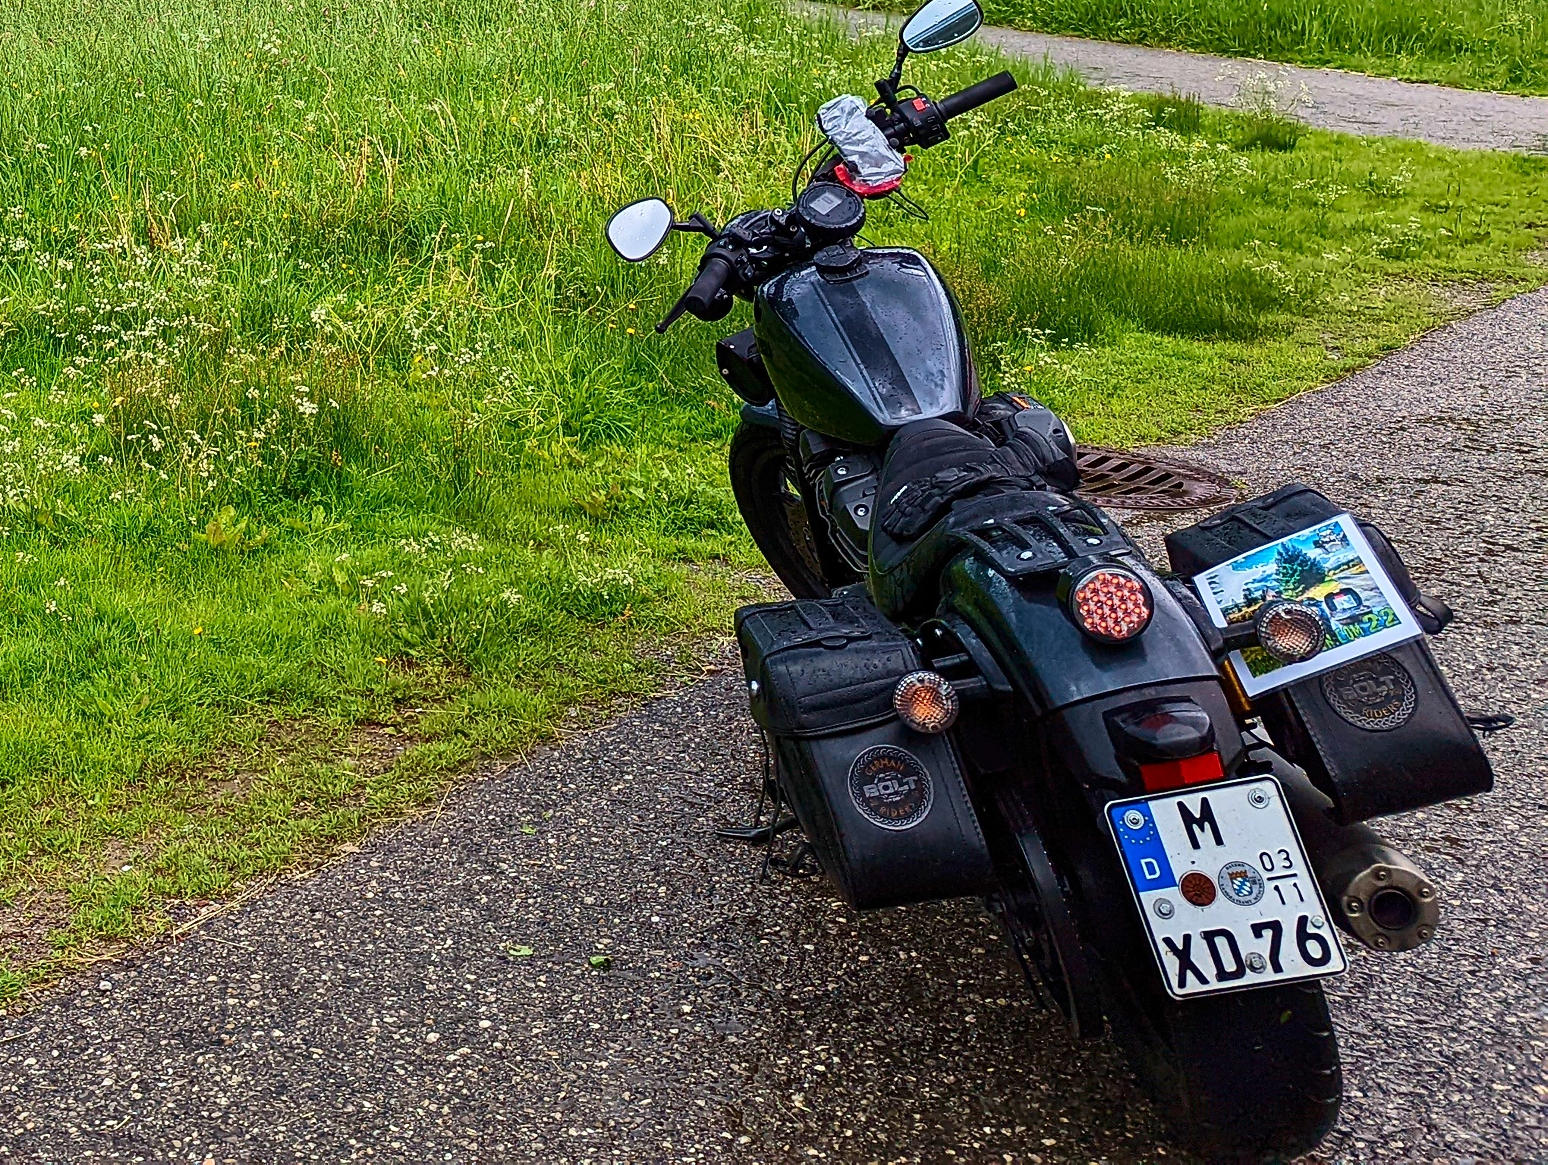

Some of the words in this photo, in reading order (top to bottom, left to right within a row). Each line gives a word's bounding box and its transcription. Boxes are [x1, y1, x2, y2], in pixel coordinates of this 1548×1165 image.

[1363, 606, 1401, 634] 22
[1362, 699, 1402, 718] RIDERS
[865, 757, 905, 776] GERMAN
[863, 776, 918, 798] BOLT
[1177, 796, 1225, 851] M
[1140, 857, 1161, 880] D
[1258, 848, 1294, 873] 03
[1273, 882, 1305, 906] 11
